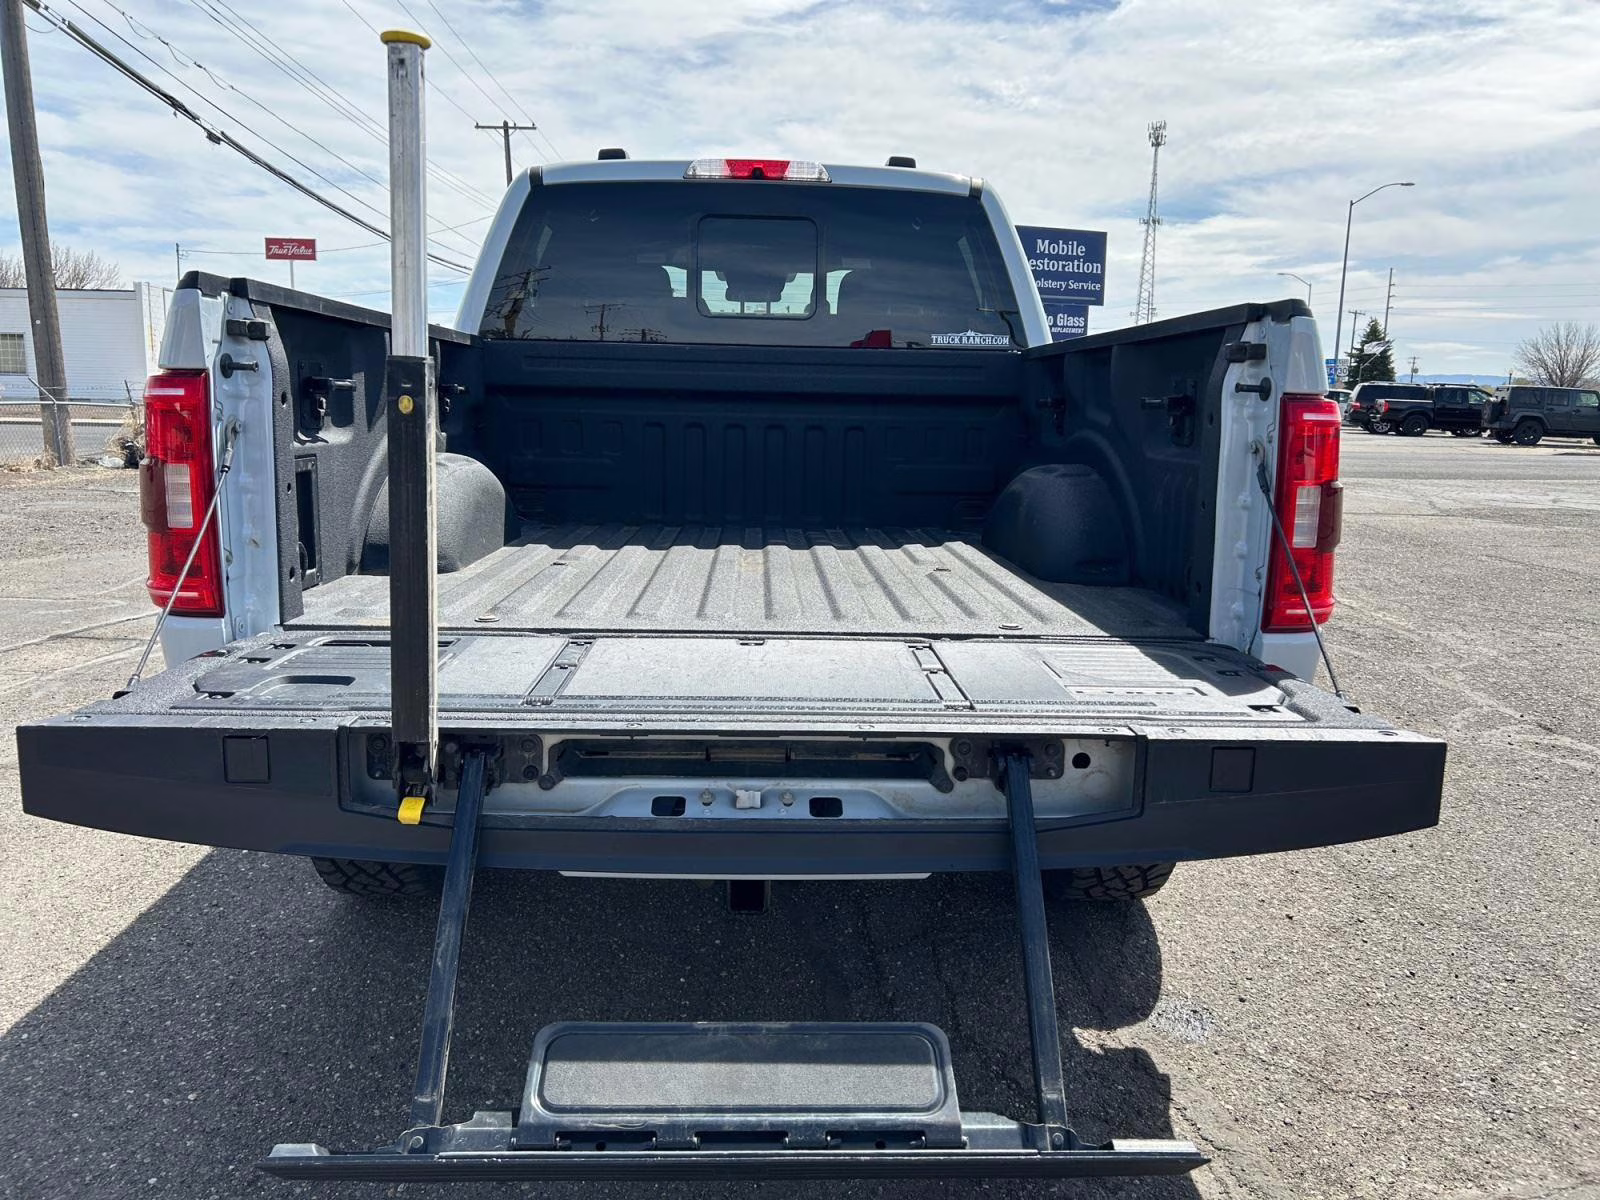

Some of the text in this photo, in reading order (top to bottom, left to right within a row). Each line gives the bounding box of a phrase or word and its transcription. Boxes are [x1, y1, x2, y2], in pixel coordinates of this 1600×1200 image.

[268, 245, 313, 256] True Value
[1036, 239, 1086, 256] Mobile
[1028, 257, 1101, 274] estoration
[1035, 278, 1101, 291] olstery Service
[1056, 313, 1085, 327] Glass
[931, 335, 961, 344] TRUCK
[1338, 367, 1348, 375] 30
